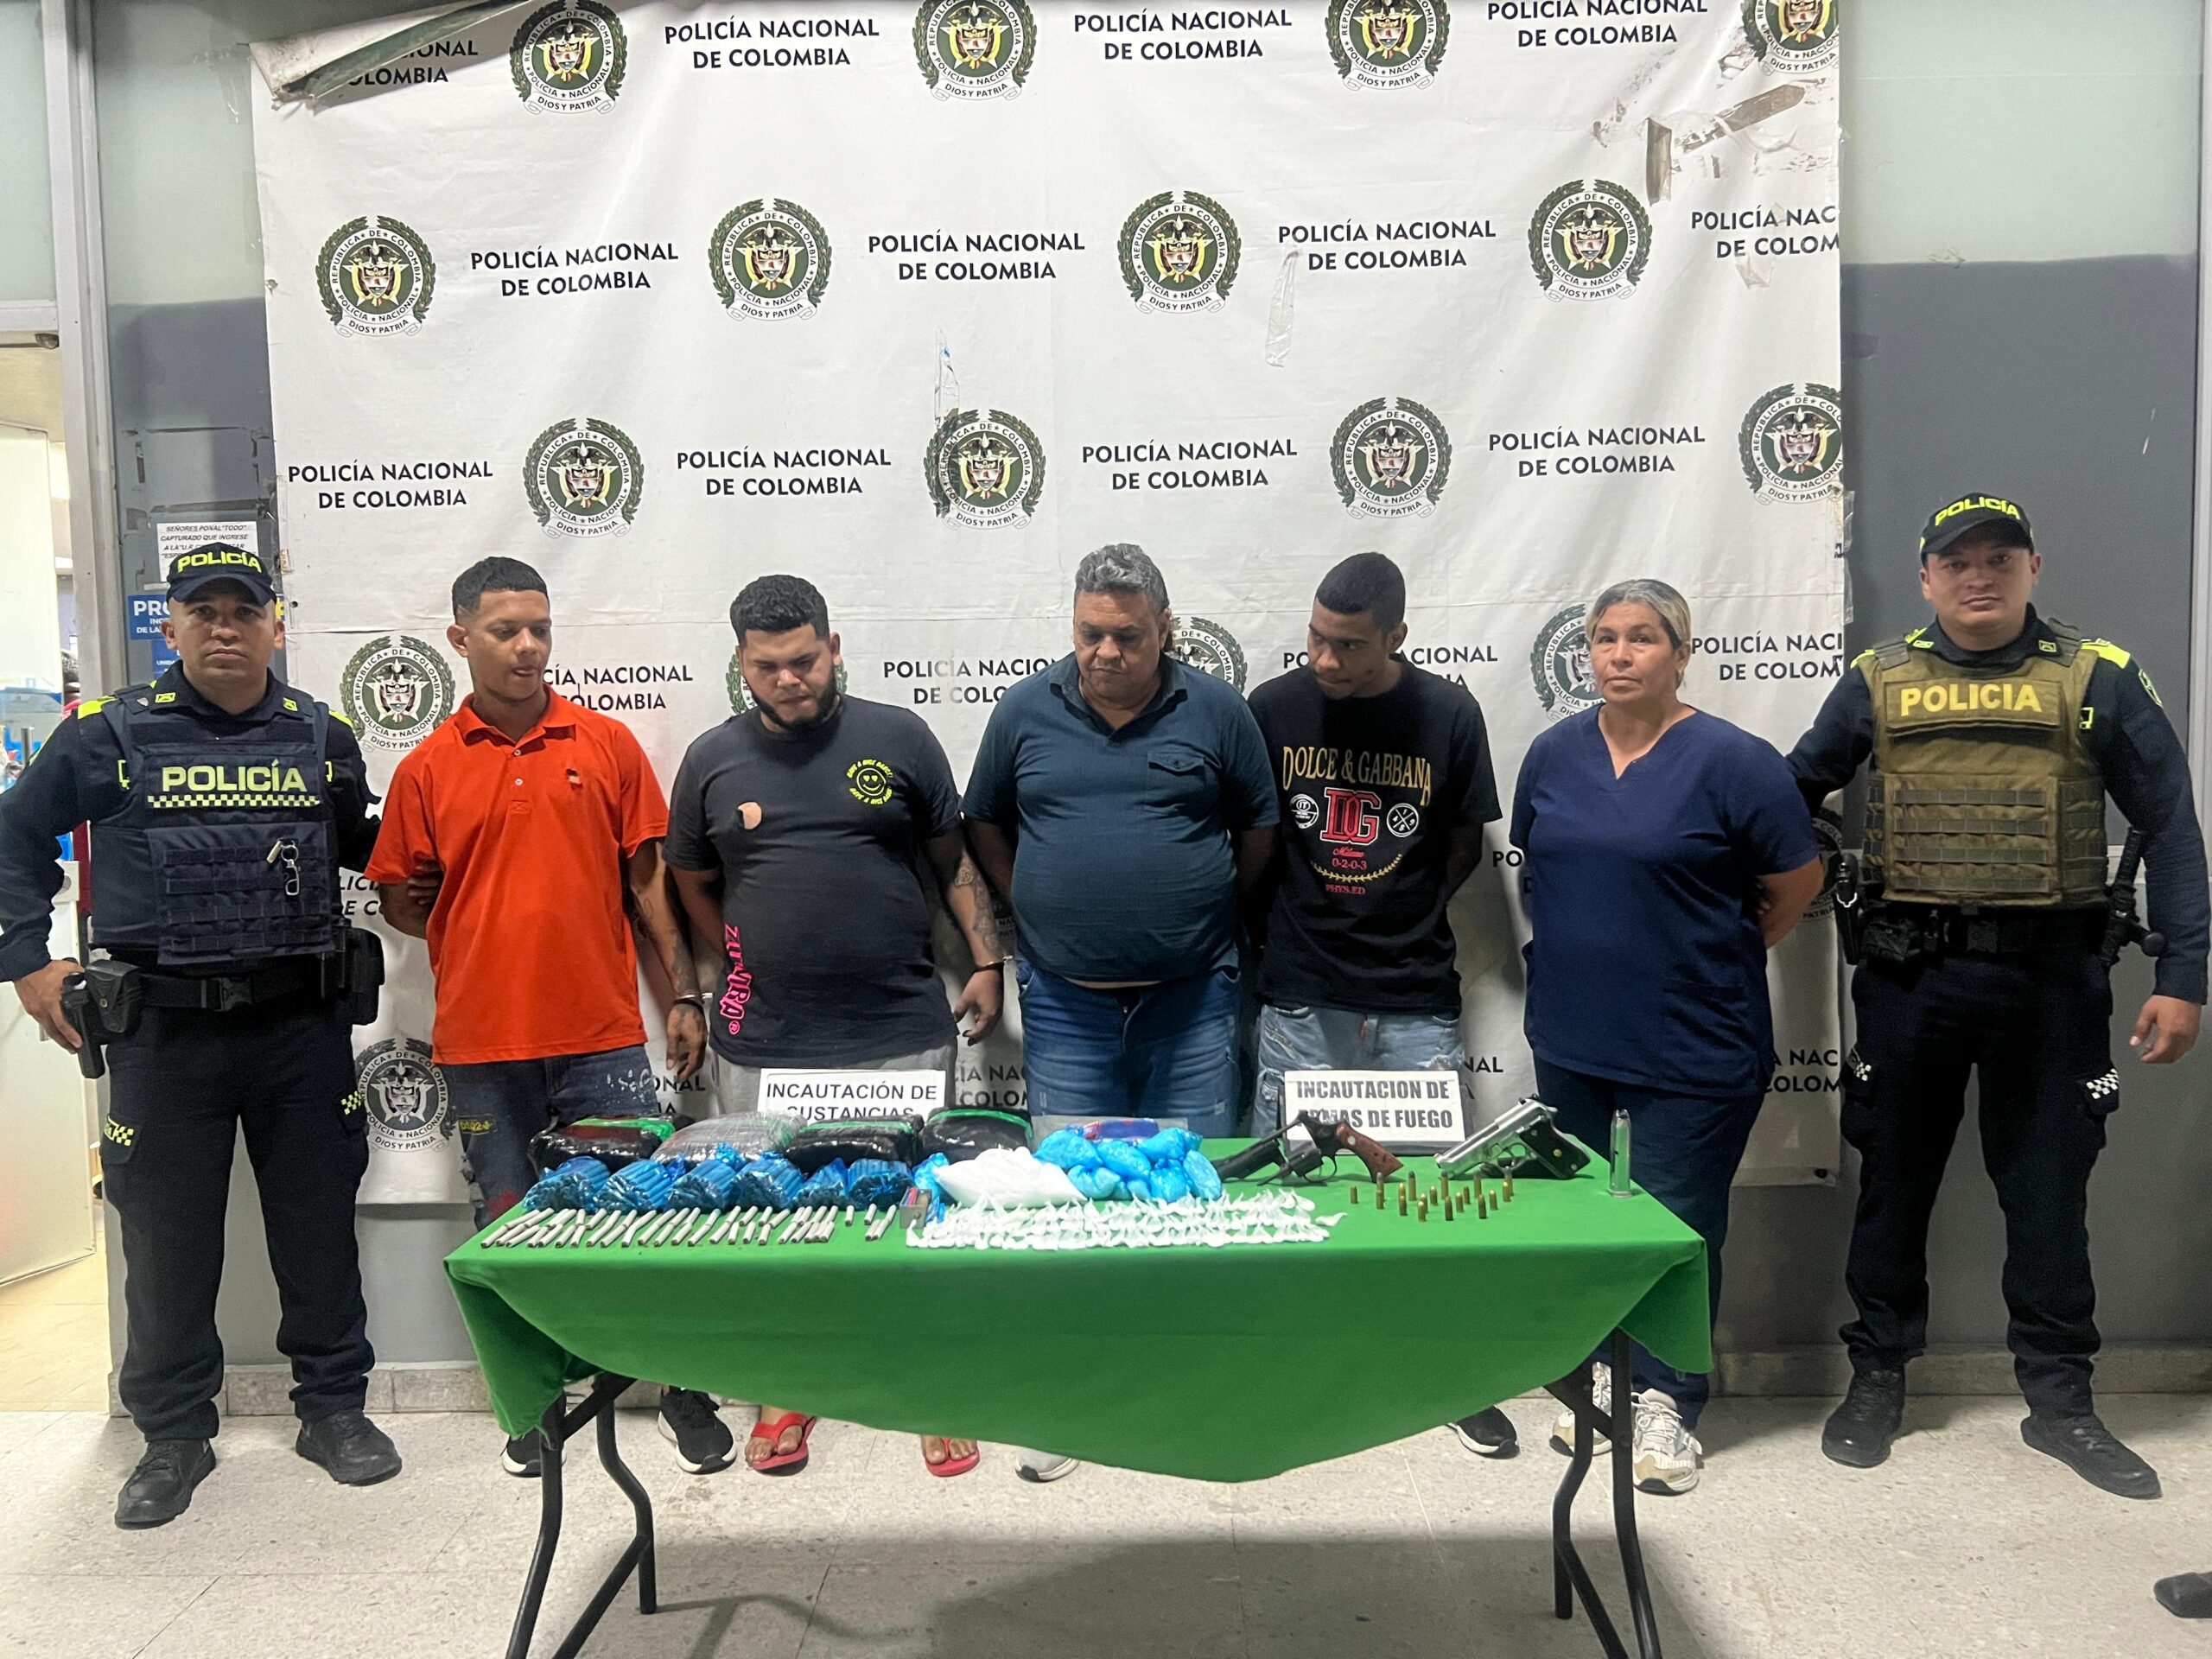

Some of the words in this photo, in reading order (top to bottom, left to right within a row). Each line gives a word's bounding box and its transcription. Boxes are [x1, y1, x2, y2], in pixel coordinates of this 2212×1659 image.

[1586, 0, 1708, 16] NACIONAL
[665, 16, 752, 44] POLICÍA
[760, 19, 880, 39] NACIONAL
[1074, 8, 1164, 33] POLICÍA
[1172, 9, 1293, 31] NACIONAL
[524, 16, 556, 61] REPUBLICA
[587, 13, 612, 56] COLOMBIA
[1518, 29, 1547, 48] DE
[1554, 24, 1678, 47] COLOMBIA
[404, 40, 479, 59] IONAL
[693, 50, 721, 69] DE
[728, 48, 851, 67] COLOMBIA
[1104, 42, 1133, 60] DE
[1141, 39, 1263, 60] COLOMBIA
[528, 72, 557, 97] POLICIA
[569, 67, 610, 99] NACIONAL
[570, 95, 601, 111] PATRIA
[1543, 199, 1573, 247] REPUBLICA
[1607, 198, 1637, 245] COLOMBIA
[1691, 204, 1779, 231] POLICÍA
[724, 218, 753, 266] REPUBLICA
[787, 219, 816, 266] COLOMBIA
[868, 228, 958, 253] POLICÍA
[966, 232, 1085, 252] NACIONAL
[1134, 211, 1163, 258] REPUBLICA
[1197, 211, 1225, 258] COLOMBIA
[1279, 218, 1369, 244] POLICÍA
[1376, 219, 1497, 241] NACIONAL
[471, 245, 559, 270] POLICÍA
[565, 243, 679, 265] NACIONAL
[1716, 239, 1746, 258] DE
[1754, 233, 1840, 255] COLOM
[332, 236, 360, 283] REPUBLICA
[392, 236, 420, 283] COLOMBIA
[899, 263, 927, 281] DE
[935, 261, 1057, 281] COLOMBIA
[1308, 252, 1337, 270] DE
[1344, 248, 1467, 270] COLOMBIA
[1139, 270, 1170, 298] POLICIA
[1181, 269, 1221, 298] NACIONAL
[1548, 258, 1580, 286] POLICIA
[1592, 257, 1631, 285] NACIONAL
[501, 279, 530, 296] DE
[537, 272, 652, 296] COLOMBIA
[730, 277, 761, 305] POLICIA
[772, 276, 813, 306] NACIONAL
[1591, 283, 1622, 298] PATRIA
[338, 294, 368, 321] POLICIA
[379, 293, 417, 321] NACIONAL
[772, 302, 804, 318] PATRIA
[1181, 296, 1211, 311] PATRIA
[379, 319, 409, 334] PATRIA
[1346, 416, 1376, 464] REPUBLICA
[1408, 417, 1436, 464] COLOMBIA
[1489, 425, 1580, 451] POLICÍA
[1588, 425, 1706, 446] NACIONAL
[677, 445, 766, 469] POLICÍA
[773, 448, 892, 468] NACIONAL
[1082, 439, 1172, 463] POLICÍA
[1179, 438, 1298, 461] NACIONAL
[288, 459, 375, 483] POLICÍA
[381, 461, 493, 481] NACIONAL
[1518, 459, 1548, 478] DE
[1555, 454, 1675, 475] COLOMBIA
[706, 478, 735, 496] DE
[742, 476, 863, 496] COLOMBIA
[1112, 472, 1141, 491] DE
[1147, 468, 1268, 490] COLOMBIA
[1351, 476, 1381, 503] POLICIA
[1392, 474, 1432, 504] NACIONAL
[318, 492, 346, 509] DE
[353, 489, 467, 509] COLOMBIA
[1391, 501, 1421, 516] PATRIA
[1400, 645, 1498, 665] CIONAL
[1691, 632, 1780, 655] POLICÍA
[1786, 632, 1842, 652] NACI
[583, 664, 694, 685] NACIONAL
[979, 658, 1055, 677] NACIO
[1719, 664, 1746, 681] DE
[1754, 660, 1841, 680] COLOM
[561, 693, 666, 710] OLOMBIA
[913, 687, 942, 704] DE
[950, 686, 1007, 705] COLO
[1901, 683, 2042, 716] POLICIA
[162, 759, 308, 792] POLICÍA
[1283, 746, 1338, 791] DOLCE
[1341, 748, 1356, 784] &
[1358, 751, 1432, 806] GABBANA
[1332, 857, 1367, 869] 0-2-0-3
[766, 1081, 904, 1100] INCAUTACIÓN
[912, 1084, 938, 1100] DE
[1297, 1080, 1421, 1099] INCAUTACION
[1427, 1080, 1451, 1099] DE
[1368, 1109, 1391, 1128] DE
[1395, 1109, 1452, 1128] FUEGO
[405, 1135, 435, 1150] PATRIA
